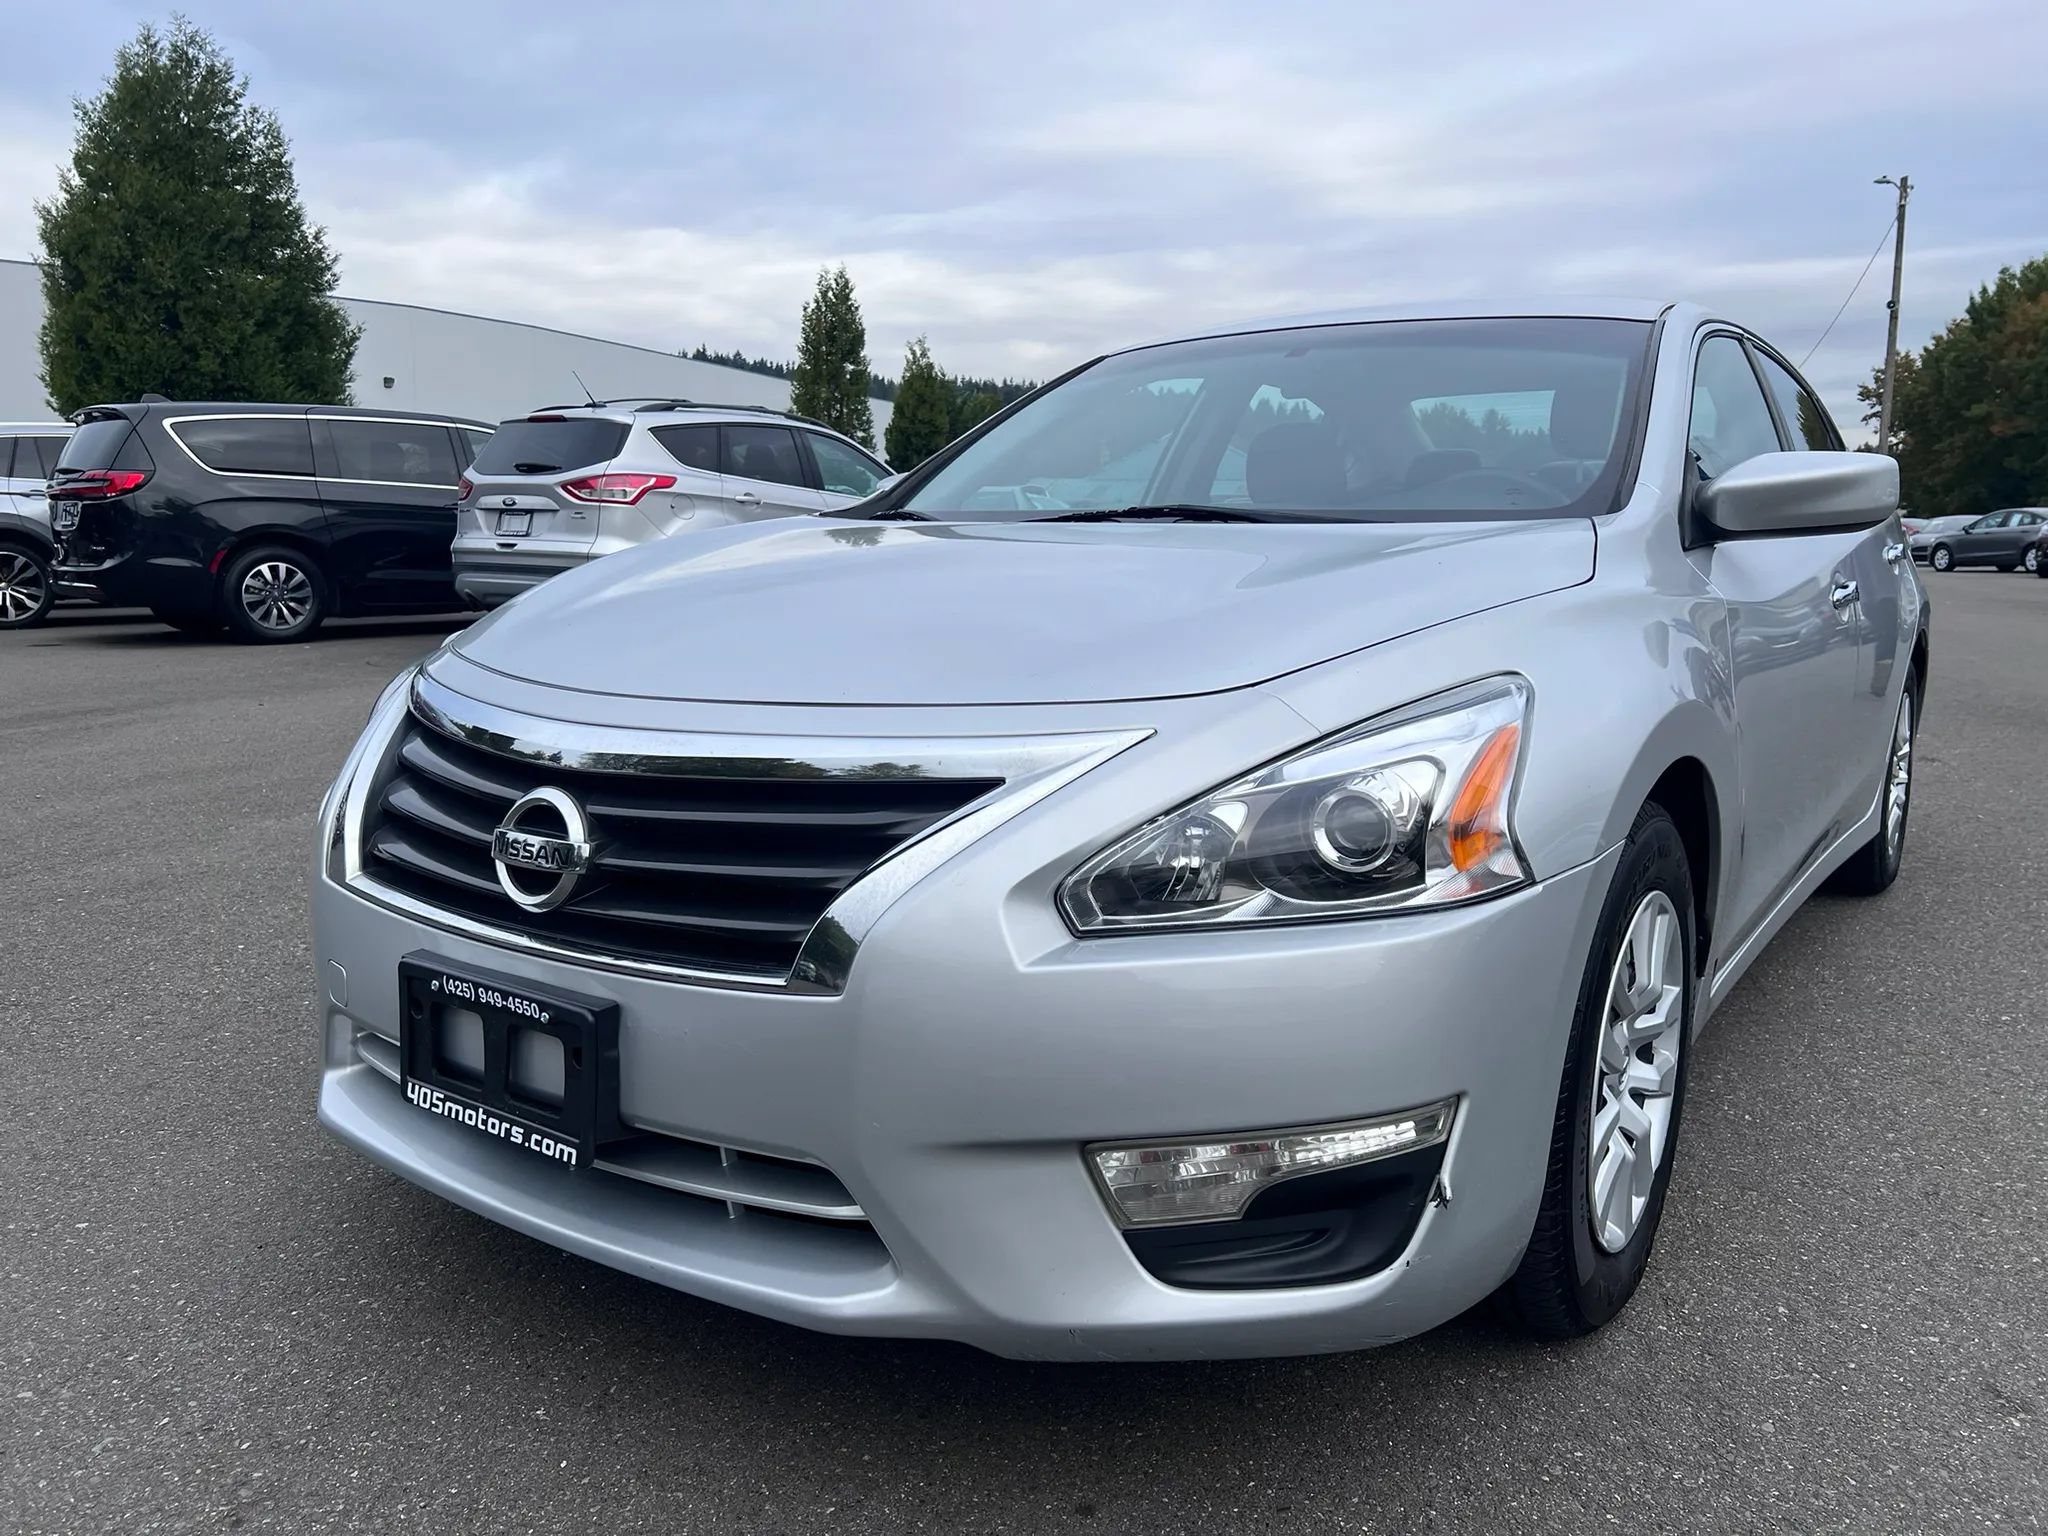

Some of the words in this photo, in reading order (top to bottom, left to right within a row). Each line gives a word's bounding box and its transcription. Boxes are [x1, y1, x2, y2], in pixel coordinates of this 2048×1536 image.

[494, 830, 574, 866] NISSAN
[443, 975, 475, 1001] (425)
[478, 987, 540, 1019] 949-4550
[407, 1082, 577, 1165] 405motors.com
